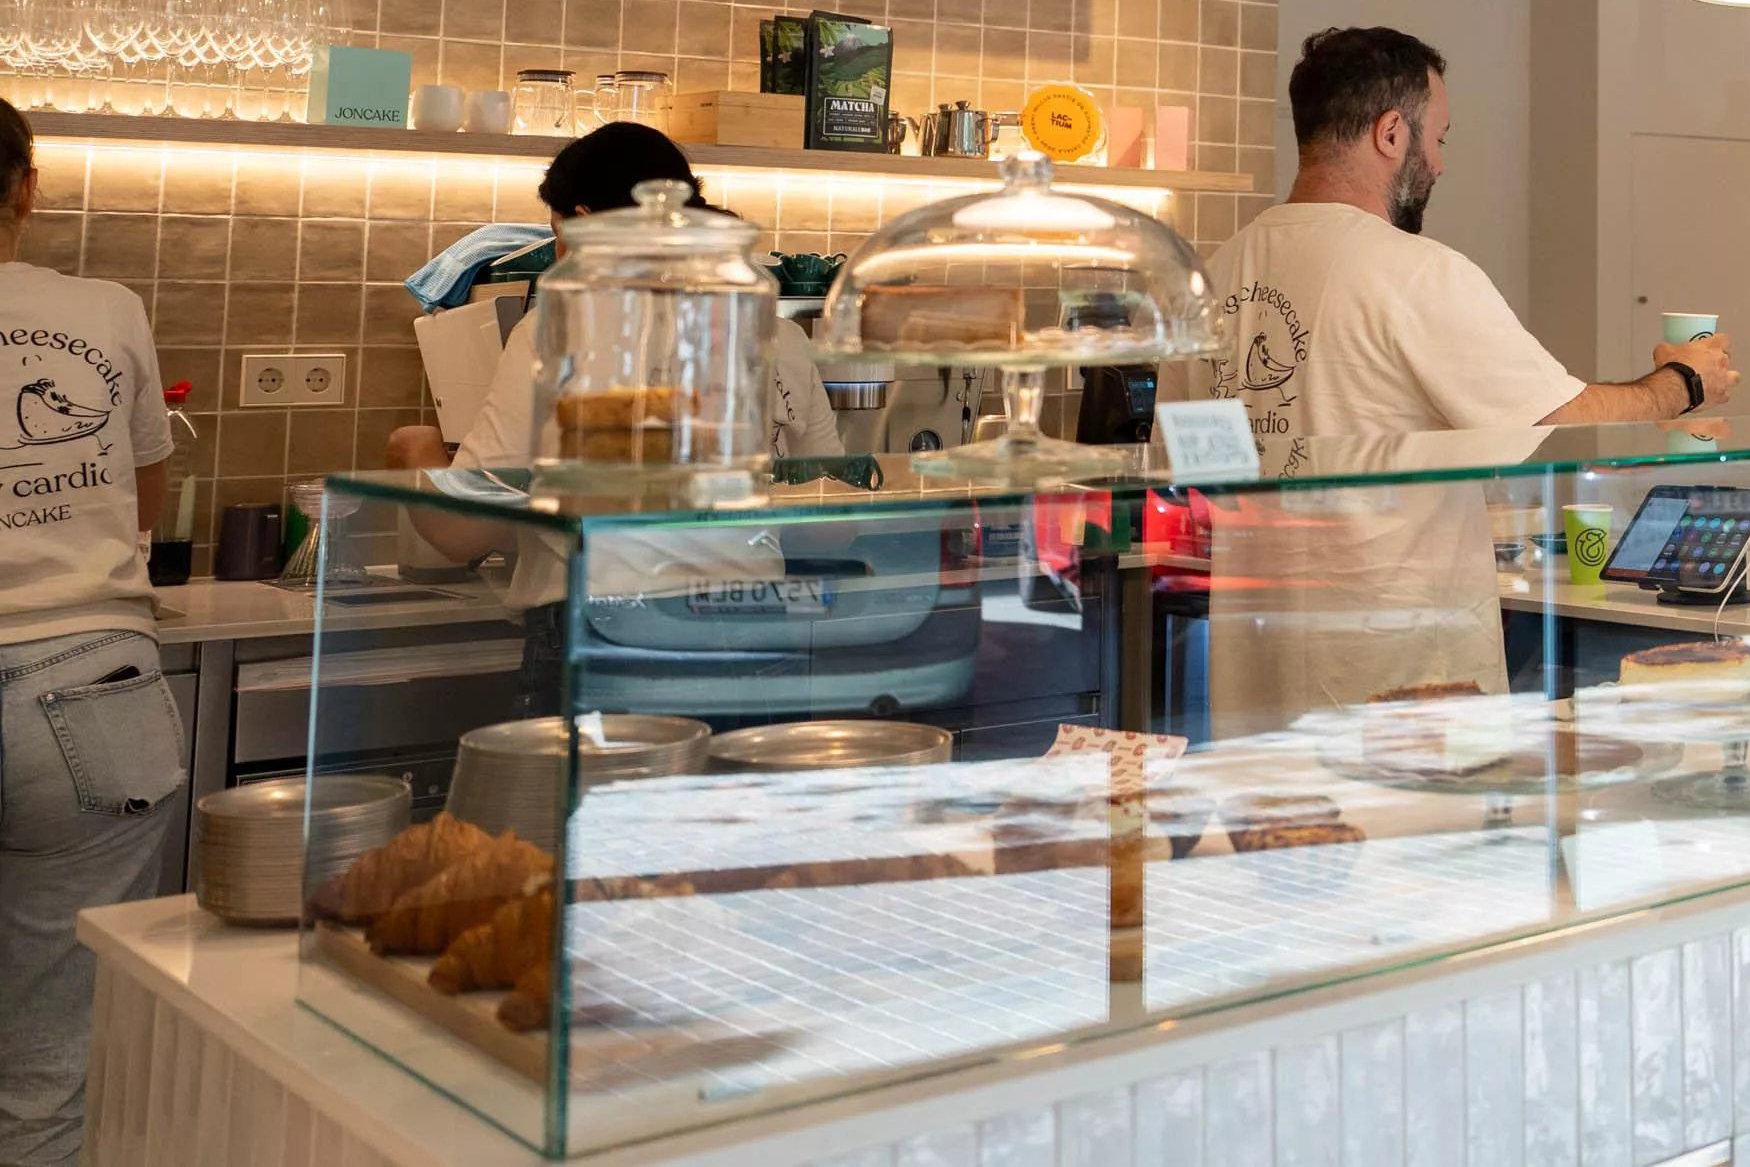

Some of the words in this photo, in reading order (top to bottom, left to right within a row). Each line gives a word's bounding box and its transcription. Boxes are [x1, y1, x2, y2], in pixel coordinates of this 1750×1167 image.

[334, 106, 401, 123] JONCAKE
[830, 100, 875, 113] MATCHA
[1240, 280, 1310, 363] cheesecake
